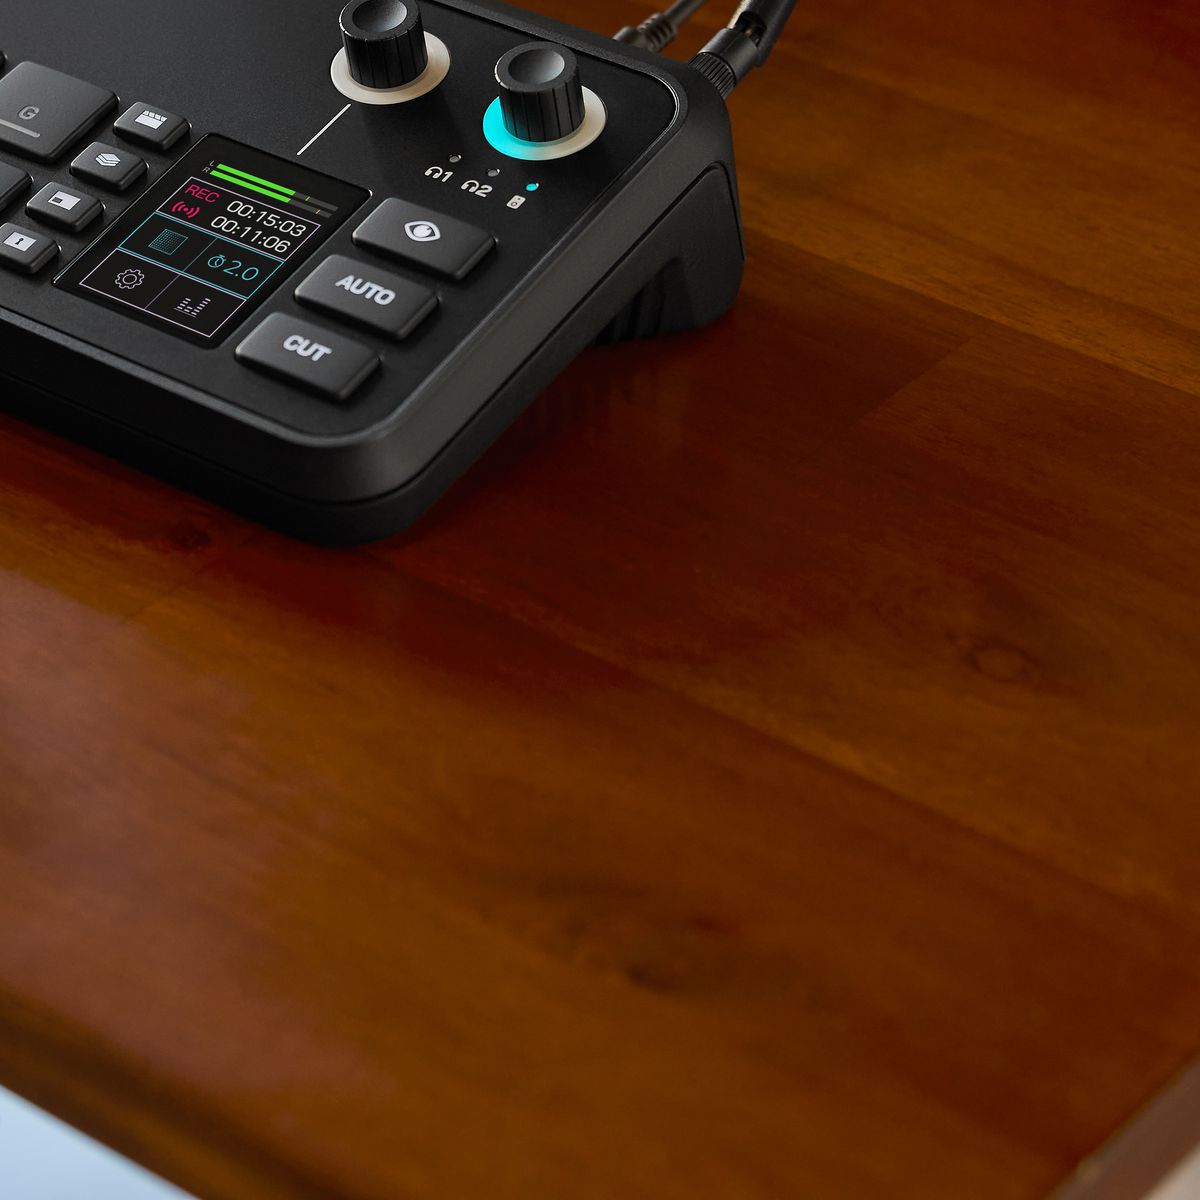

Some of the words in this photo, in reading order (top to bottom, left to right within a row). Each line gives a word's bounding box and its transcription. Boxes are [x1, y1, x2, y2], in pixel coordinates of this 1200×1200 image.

[18, 105, 40, 120] G
[184, 184, 220, 203] REC
[226, 200, 307, 237] 00:15:03
[210, 216, 291, 253] 00:11:06
[223, 260, 259, 281] 2.0
[335, 274, 396, 306] AUTO
[283, 334, 333, 362] CUT
